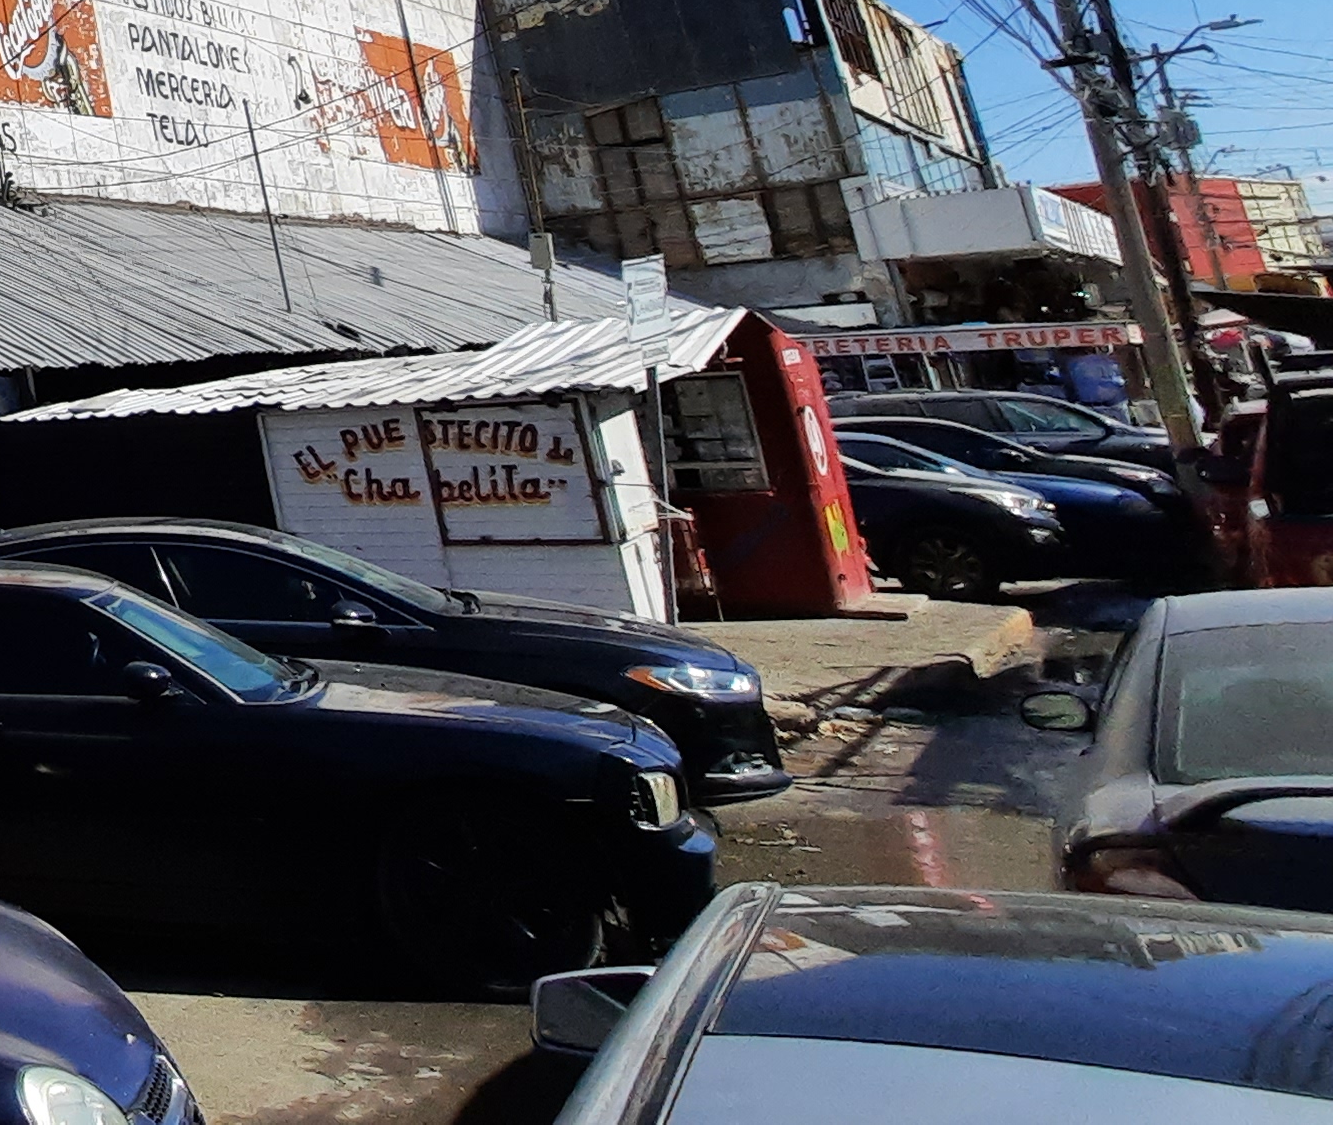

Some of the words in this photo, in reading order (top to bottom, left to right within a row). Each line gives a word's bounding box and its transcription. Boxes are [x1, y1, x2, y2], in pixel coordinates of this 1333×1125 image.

[128, 23, 251, 74] PANTALONES
[136, 67, 237, 110] MERCERIA
[146, 112, 209, 147] TELAS
[797, 332, 953, 356] RETERIA
[978, 325, 1123, 348] TRUPER
[292, 444, 336, 481] EL
